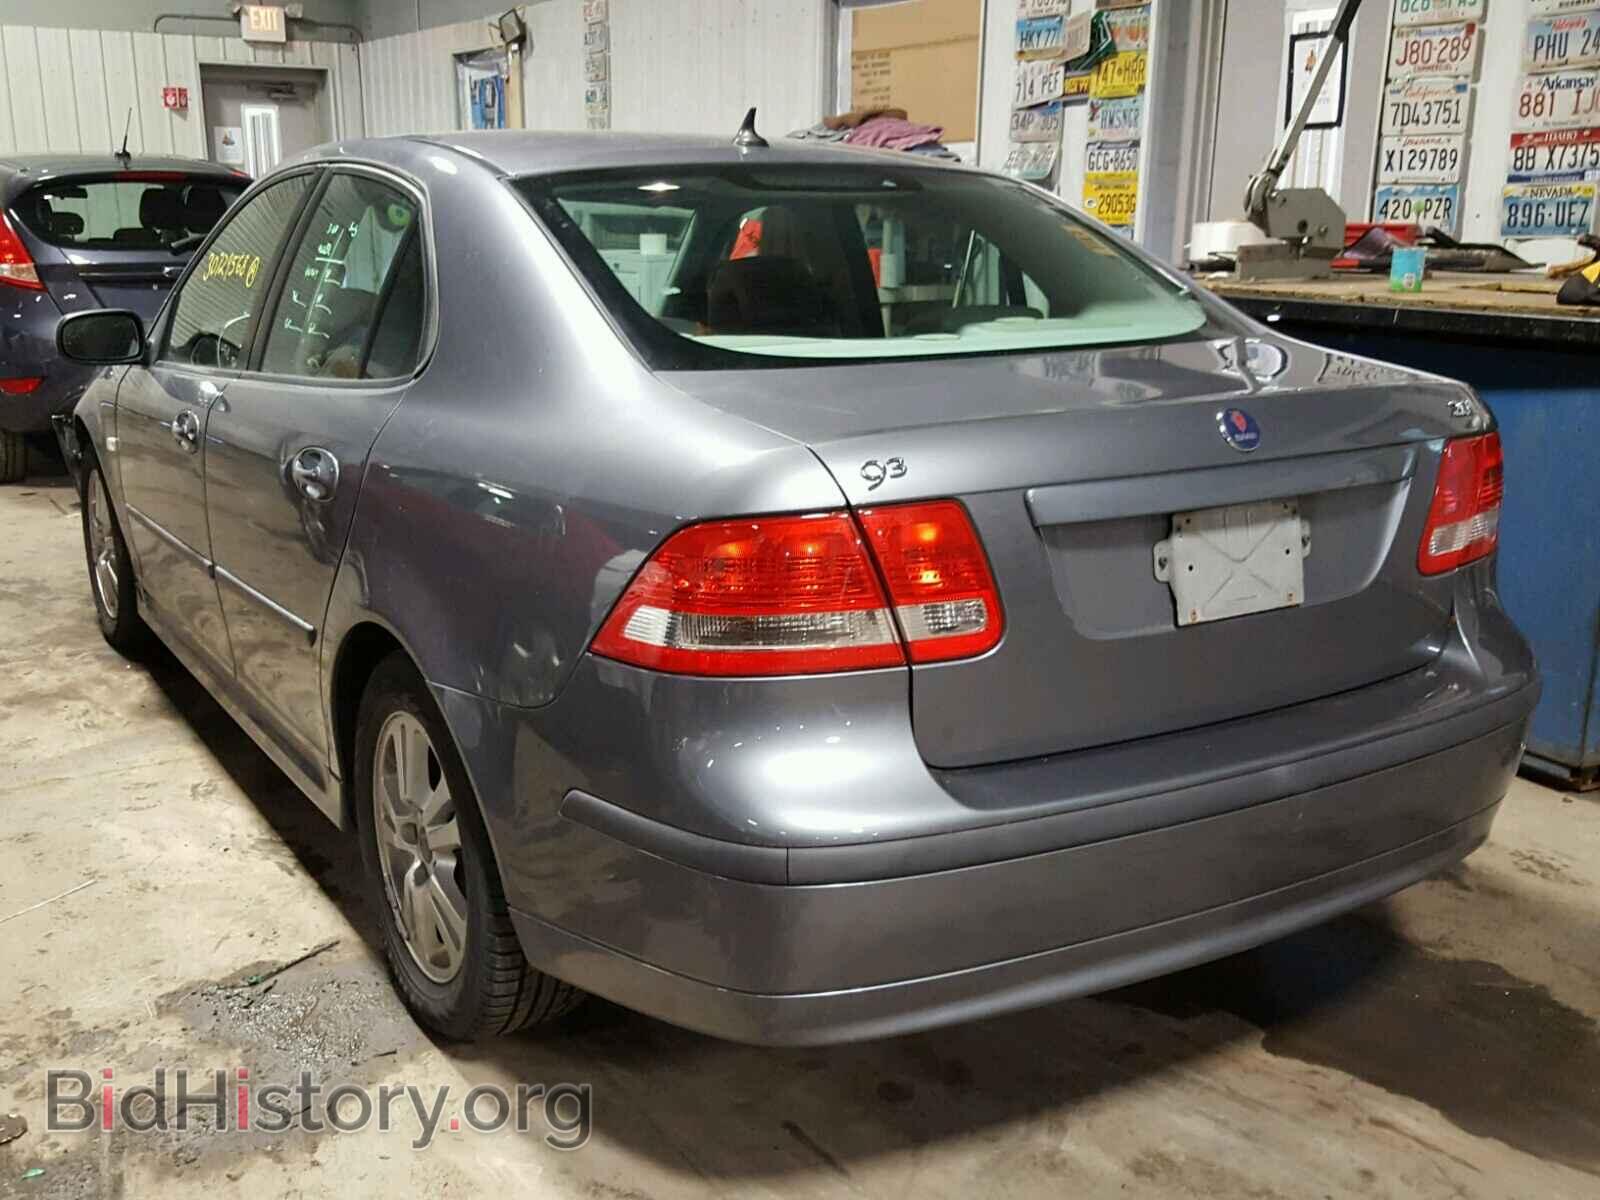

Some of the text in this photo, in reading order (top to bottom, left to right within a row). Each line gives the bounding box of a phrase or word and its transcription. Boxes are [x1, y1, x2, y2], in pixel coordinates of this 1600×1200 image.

[249, 7, 279, 31] EXIT
[1532, 30, 1570, 62] PHU
[1541, 76, 1594, 91] Arkansas
[1390, 99, 1461, 127] 7D43751
[1519, 92, 1555, 118] 881
[1383, 148, 1458, 172] X129789
[1545, 141, 1600, 171] X7375
[1529, 186, 1574, 199] NEVADA
[1379, 197, 1453, 220] 420 PZR
